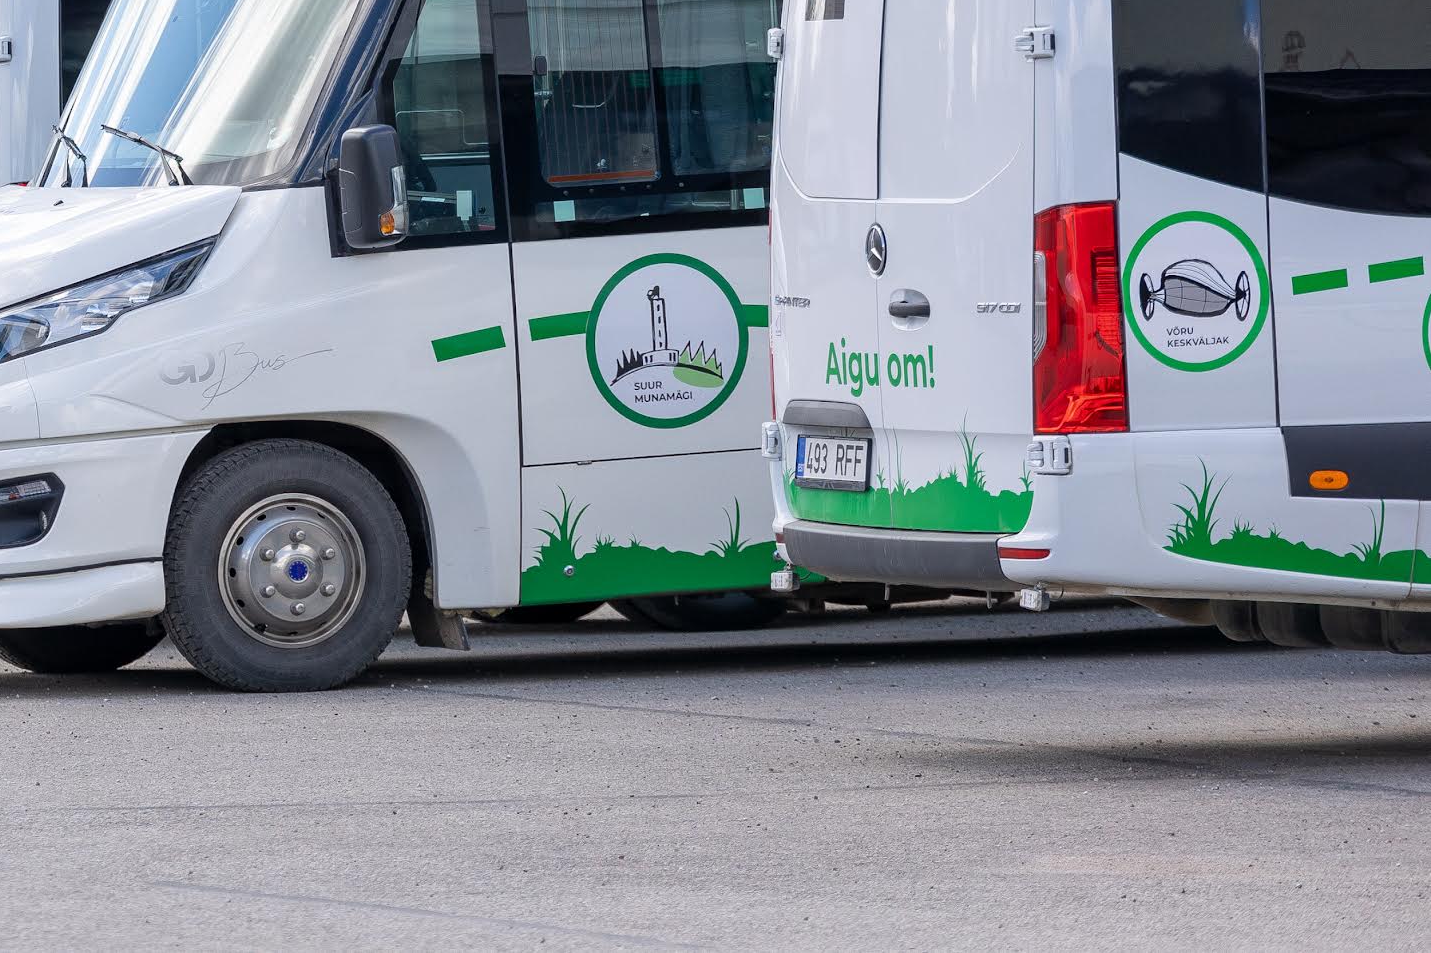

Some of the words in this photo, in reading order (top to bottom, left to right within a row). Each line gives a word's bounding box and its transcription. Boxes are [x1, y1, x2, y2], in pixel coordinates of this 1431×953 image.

[1166, 326, 1194, 336] VÕRU
[1167, 336, 1229, 348] KESKVÄLJAK
[825, 337, 880, 398] Aigu
[887, 344, 936, 388] om!
[201, 342, 334, 411] Bus
[634, 380, 663, 391] SUUR
[634, 390, 693, 404] MUNAMÄGI
[806, 442, 828, 474] 493
[834, 443, 864, 477] RFF
